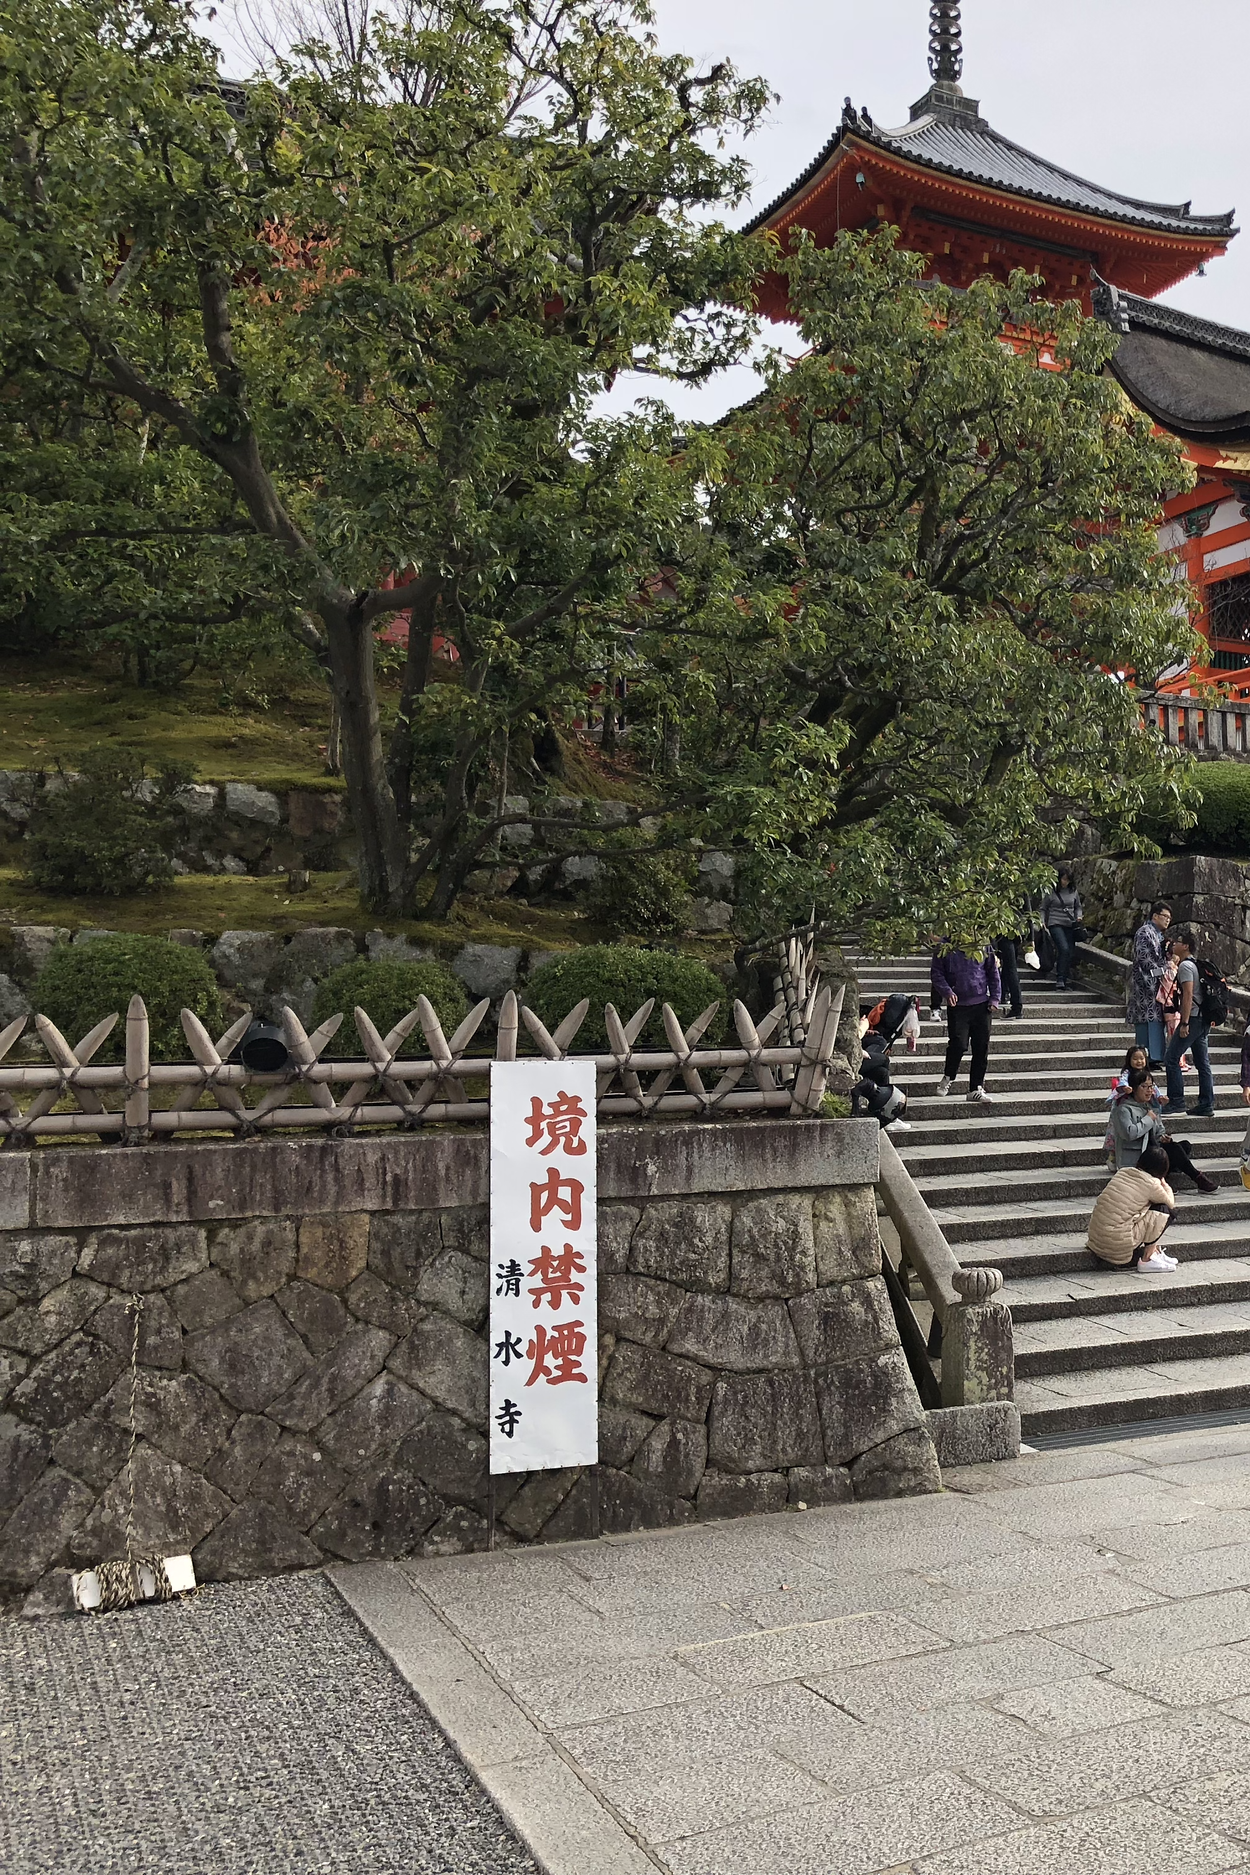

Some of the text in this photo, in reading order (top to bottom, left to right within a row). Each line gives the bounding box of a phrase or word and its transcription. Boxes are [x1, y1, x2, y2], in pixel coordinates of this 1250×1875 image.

[493, 1258, 525, 1439] 清水寺
[523, 1090, 588, 1387] 境内禁煙
